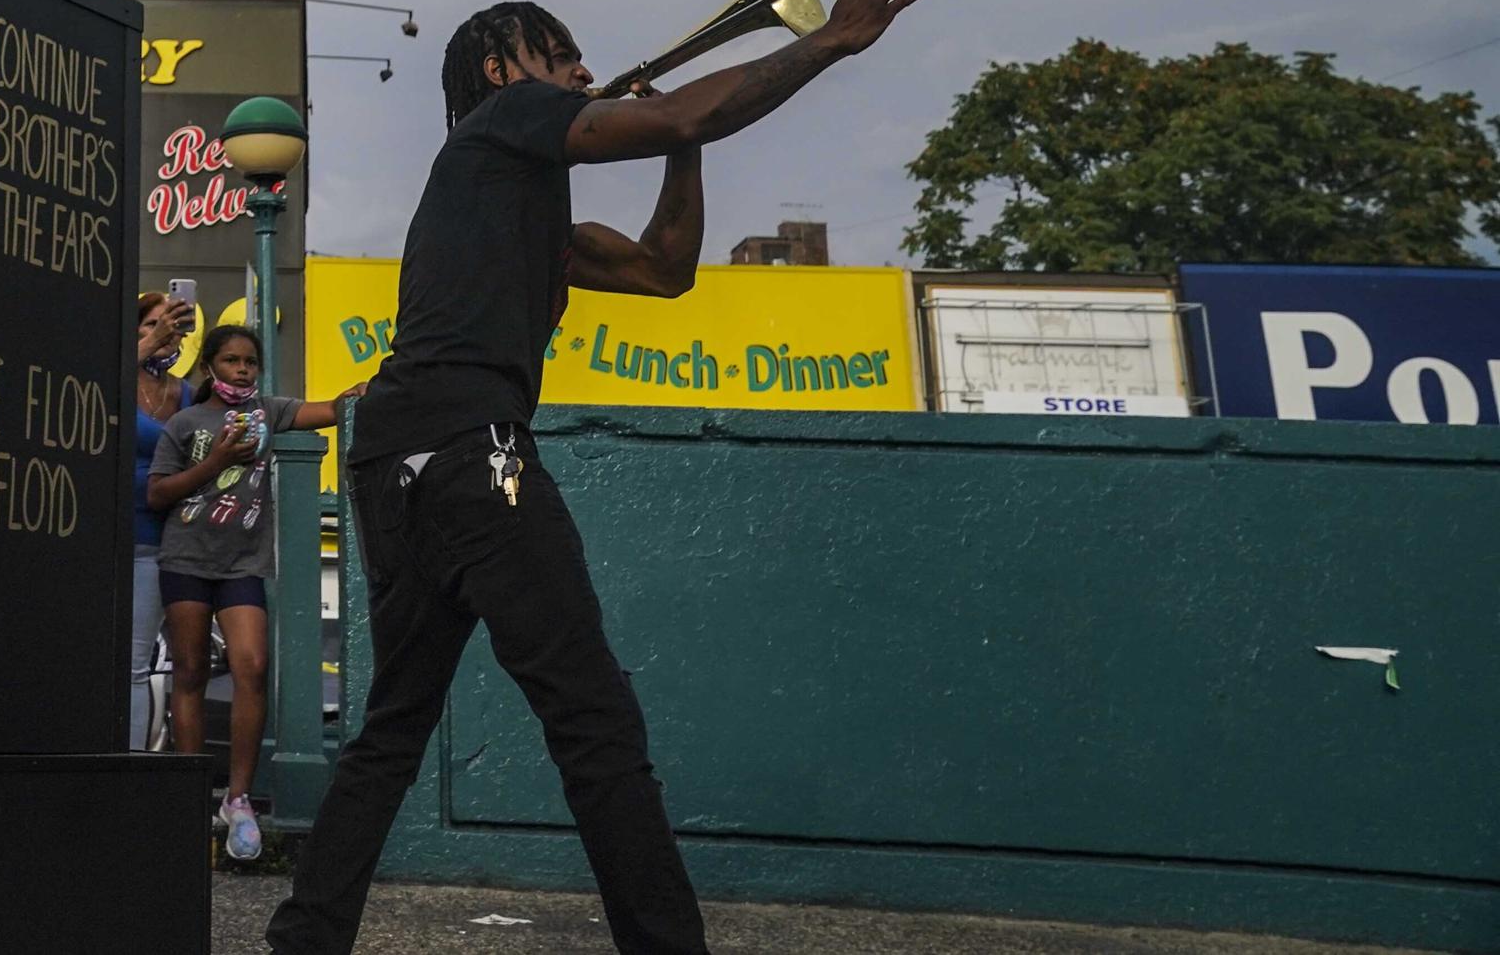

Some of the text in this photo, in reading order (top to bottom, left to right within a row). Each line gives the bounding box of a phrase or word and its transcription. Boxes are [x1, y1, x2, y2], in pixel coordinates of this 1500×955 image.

[158, 126, 233, 180] Re
[147, 174, 287, 234] Velv
[51, 204, 113, 286] EARS
[590, 324, 719, 391] Lunch
[746, 343, 890, 392] Dinner
[1260, 311, 1500, 426] Po
[1043, 397, 1127, 413] STORE
